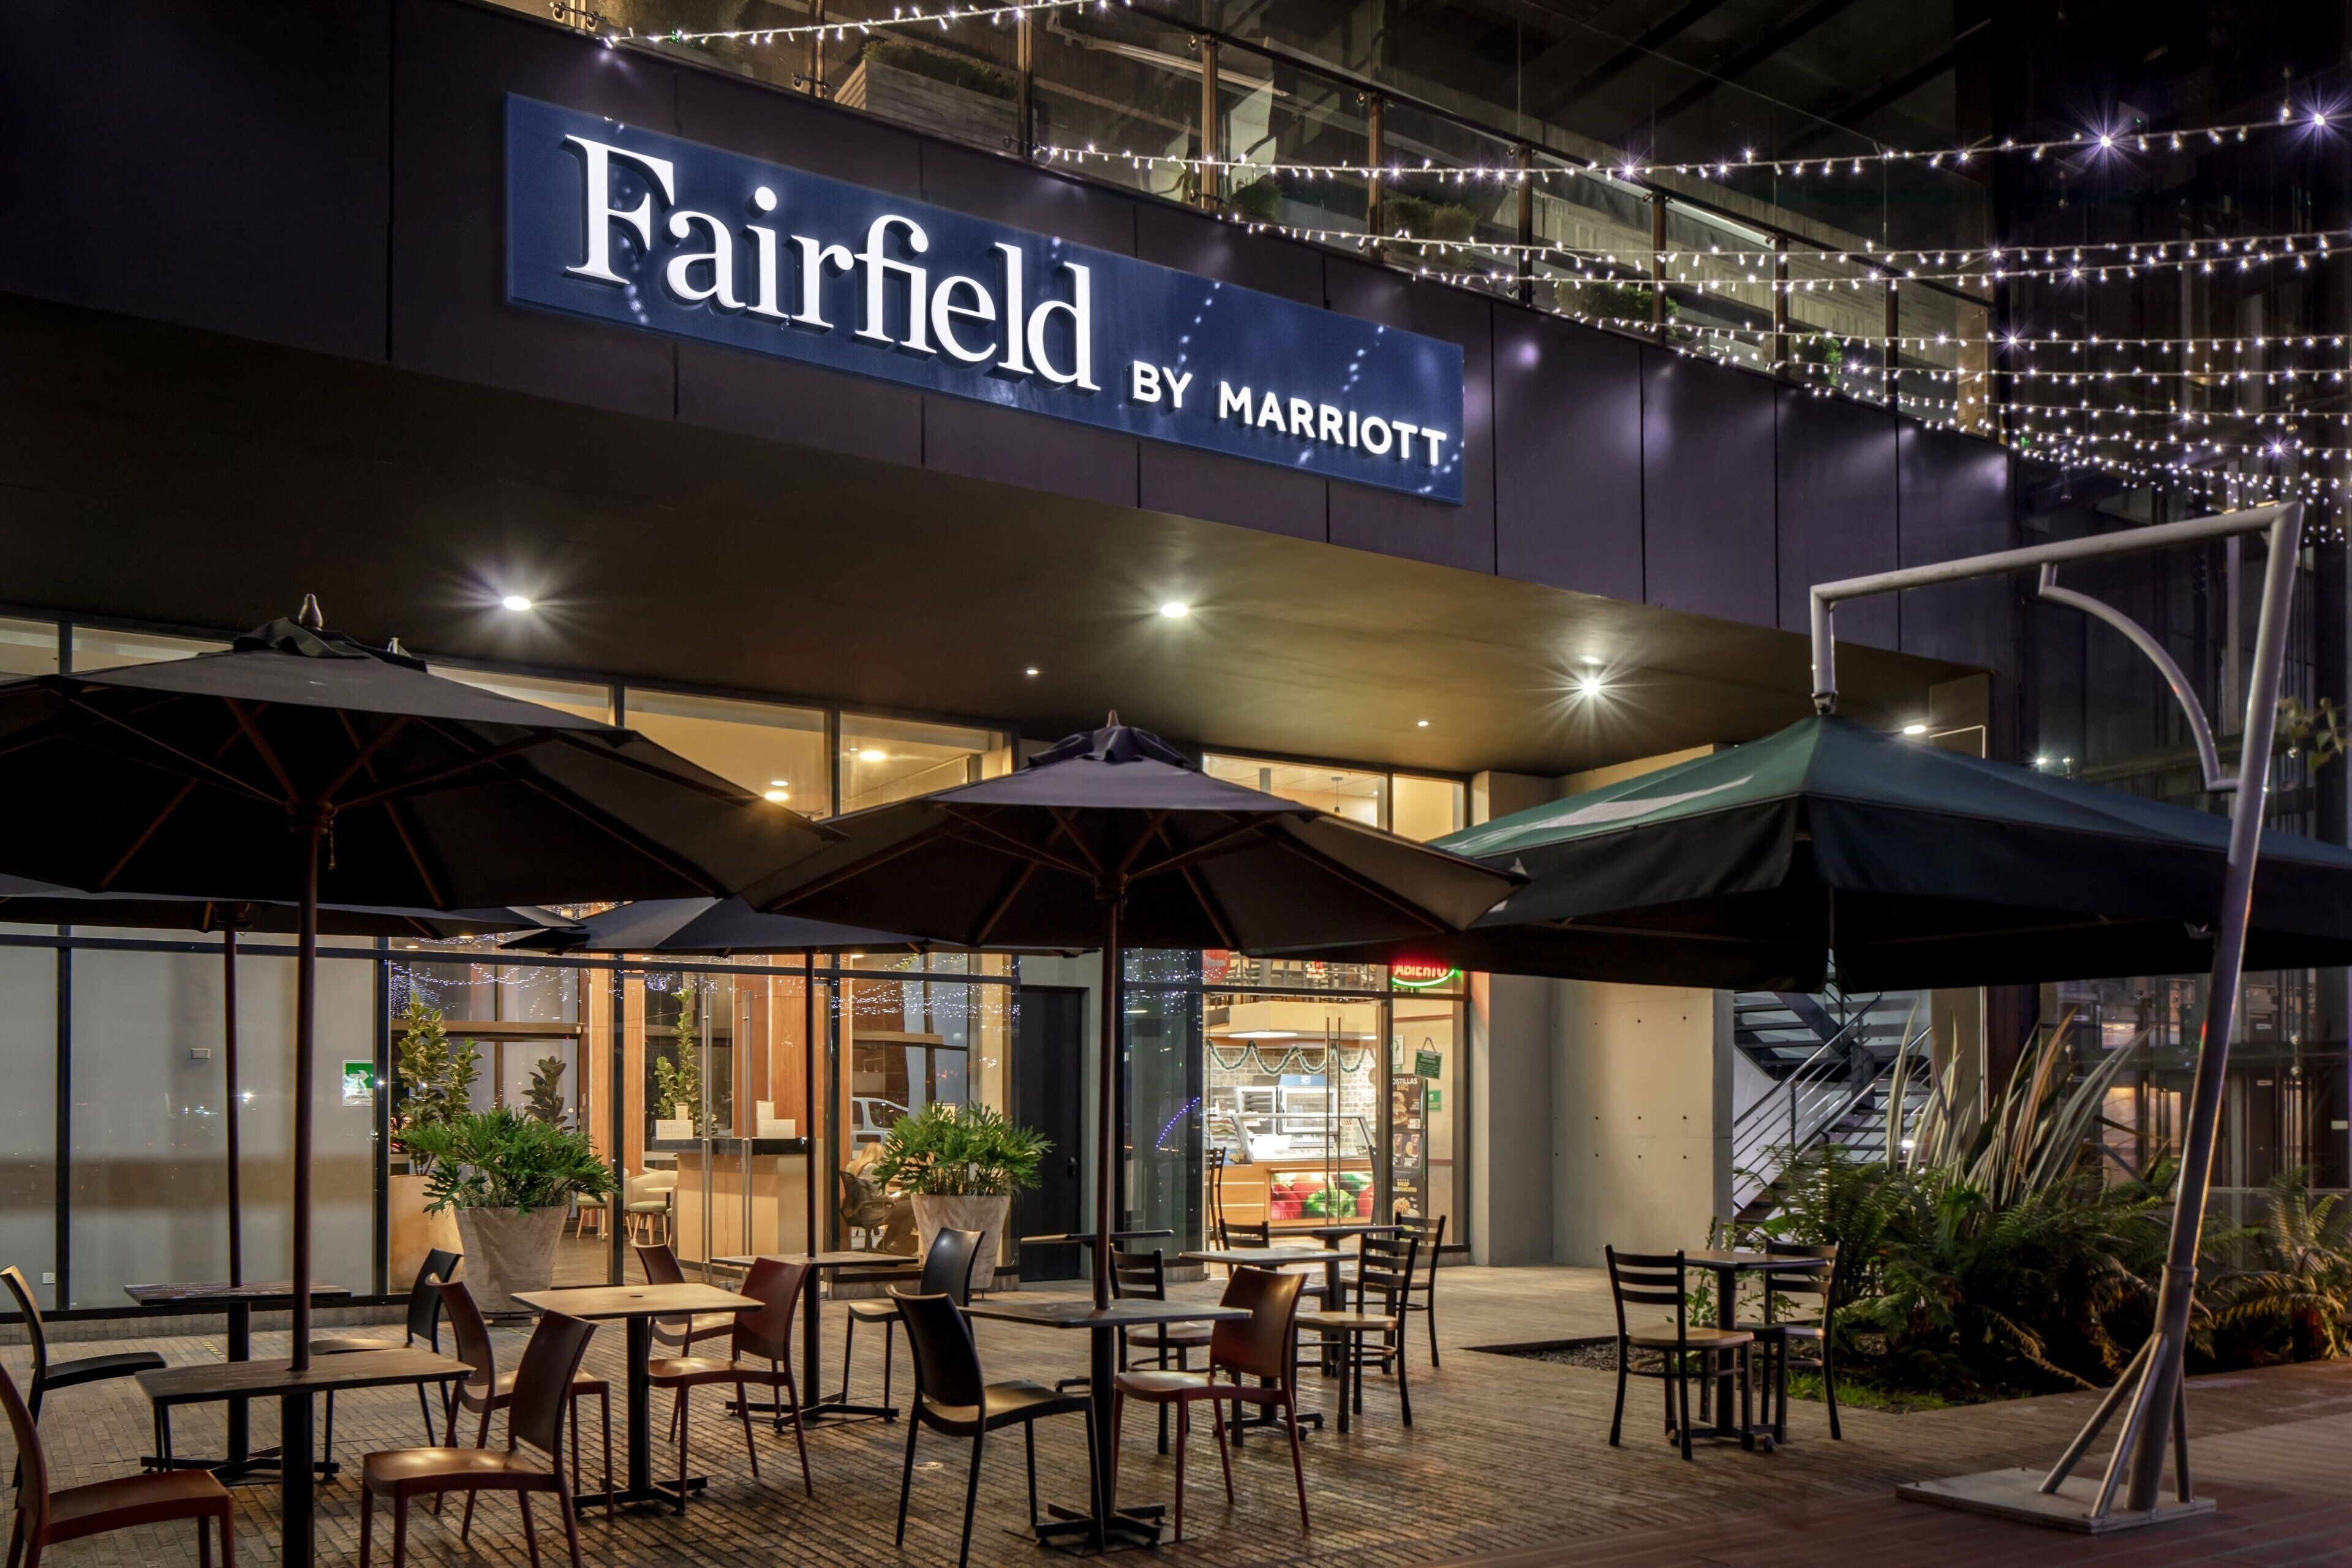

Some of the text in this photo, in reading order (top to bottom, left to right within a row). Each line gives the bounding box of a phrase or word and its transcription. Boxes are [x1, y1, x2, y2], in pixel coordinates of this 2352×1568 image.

[566, 134, 1447, 467] Fairfield BY MARRIOTT
